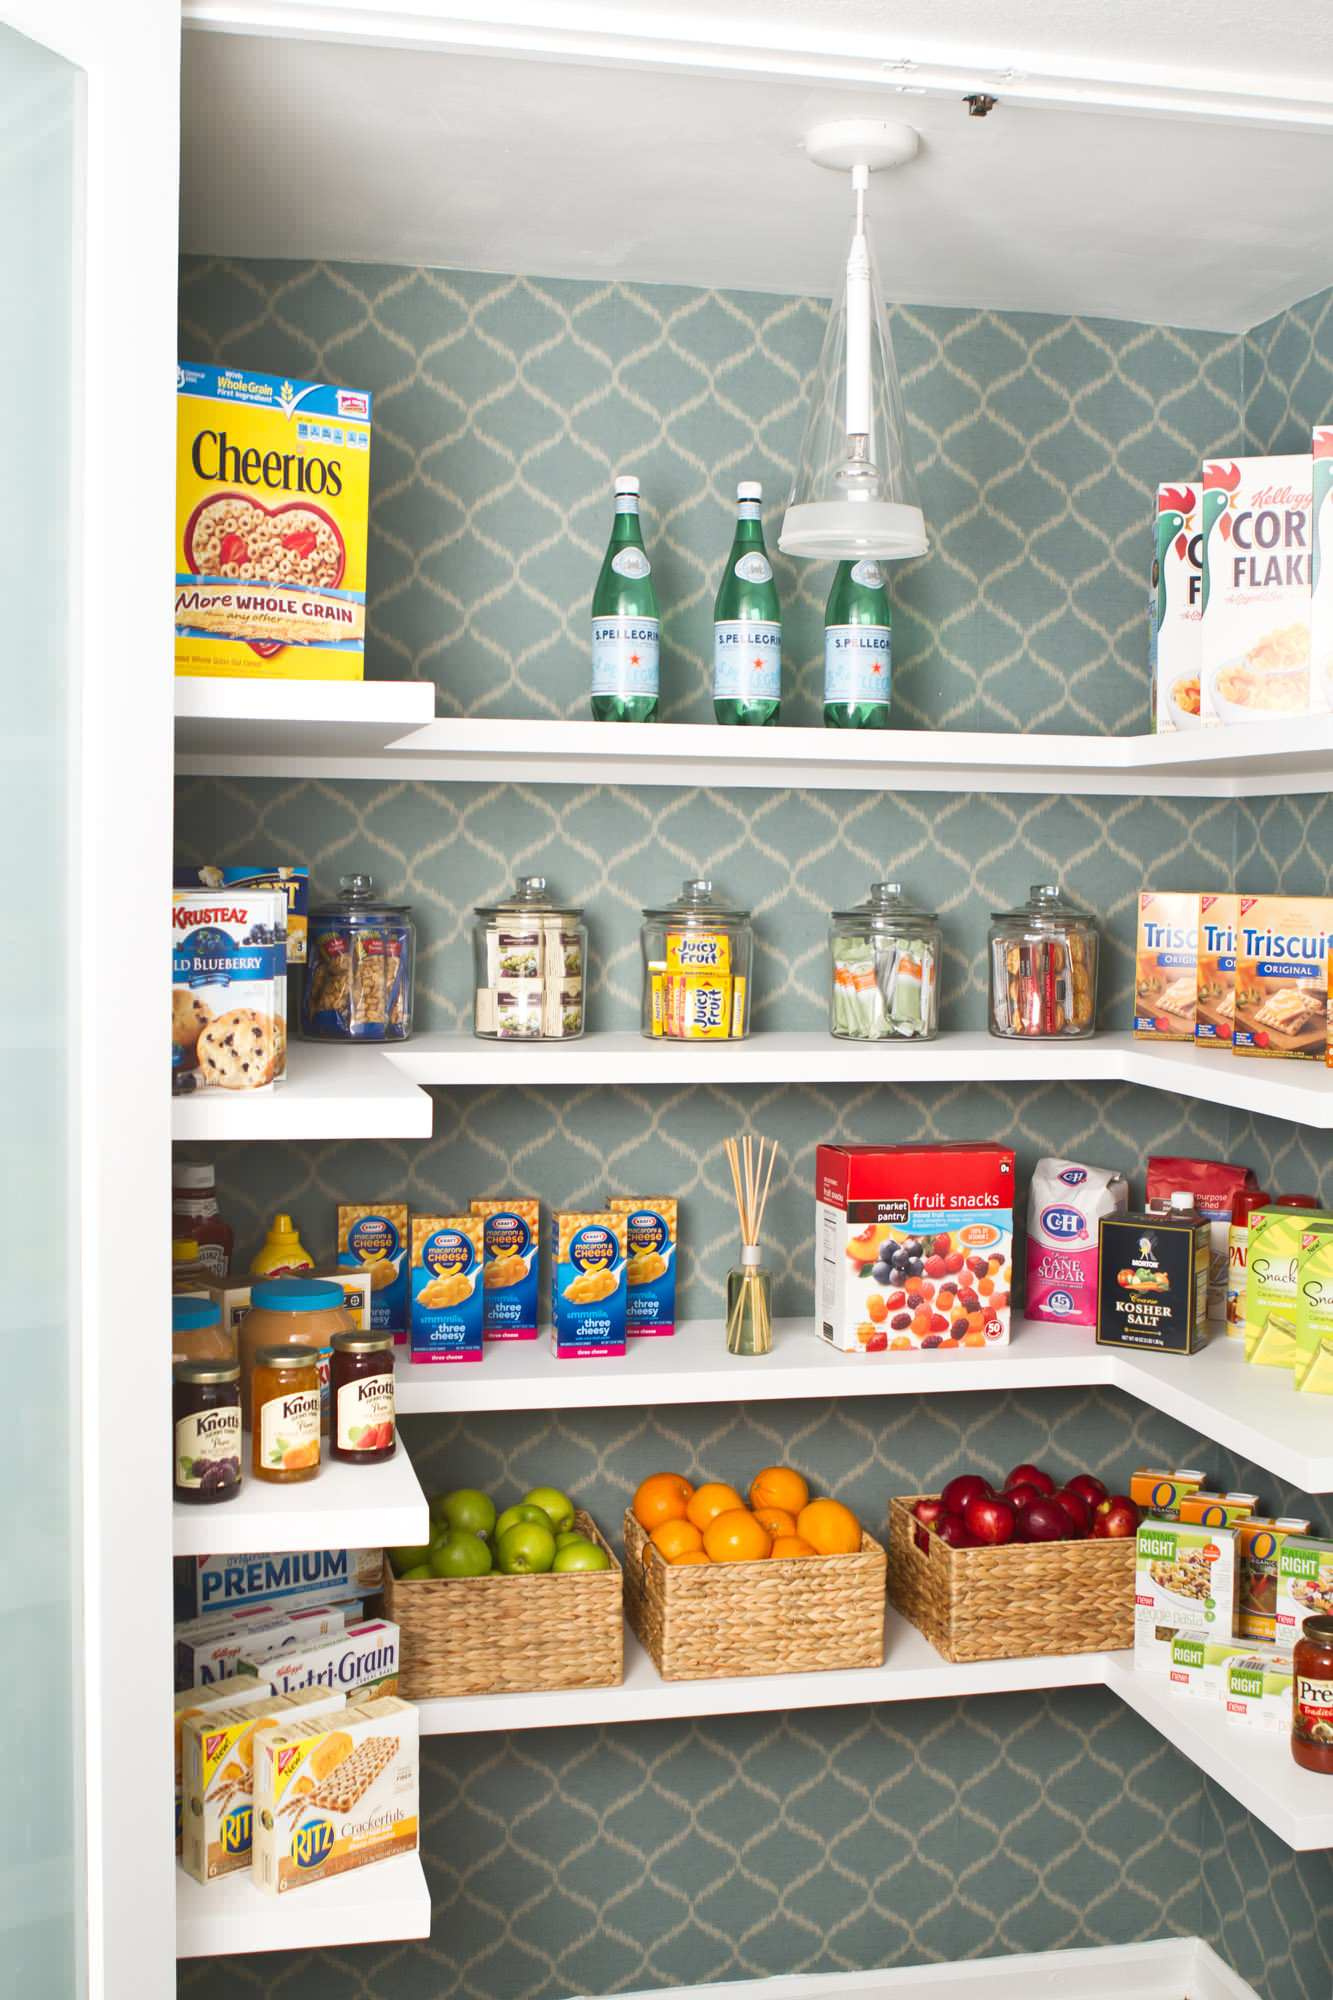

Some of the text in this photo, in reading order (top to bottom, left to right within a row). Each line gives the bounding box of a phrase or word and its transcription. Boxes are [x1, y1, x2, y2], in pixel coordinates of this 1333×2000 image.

[217, 375, 247, 392] Whole
[248, 380, 274, 396] Grain
[191, 430, 343, 497] Cheerios
[1231, 510, 1307, 549] COR
[175, 592, 353, 623] More WHOLE GRAIN
[173, 906, 249, 929] KRUSTEAZ
[677, 940, 717, 953] Juicy
[193, 956, 262, 972] BLUEBERRY
[680, 952, 717, 964] Fruit
[1263, 964, 1313, 976] ORIGINAL
[694, 988, 709, 1028] Juicy
[707, 988, 722, 1026] Fruit
[1061, 1171, 1083, 1183] C&H
[878, 1202, 907, 1211] market
[913, 1193, 999, 1208] fruit snacks
[877, 1212, 906, 1223] pantry
[1046, 1213, 1079, 1233] C&H
[575, 1242, 608, 1250] macaroni
[1042, 1256, 1081, 1271] CANE
[1131, 1259, 1160, 1269] MORTON
[1251, 1258, 1297, 1284] Snack
[1038, 1266, 1085, 1282] SUGAR
[1054, 1296, 1067, 1305] 15
[1303, 1281, 1333, 1307] Sna
[495, 1303, 522, 1312] three
[634, 1299, 660, 1308] three
[1115, 1301, 1173, 1318] KOSHER
[488, 1312, 521, 1321] cheesy
[627, 1308, 660, 1317] cheesy
[438, 1323, 467, 1332] three
[583, 1318, 612, 1328] three
[987, 1323, 1000, 1333] 50
[1127, 1314, 1160, 1327] SALT
[430, 1332, 466, 1342] cheesy
[576, 1327, 610, 1337] cheesy
[1138, 1538, 1175, 1557] RIGHT
[1280, 1557, 1318, 1576] RIGHT
[202, 1549, 348, 1602] PREMIUM
[1173, 1647, 1204, 1666] RIGHT
[1231, 1677, 1262, 1696] RIGHT
[212, 1738, 231, 1763] New!
[284, 1752, 302, 1777] New!
[223, 1809, 253, 1853] RIT
[291, 1822, 333, 1865] RITZ
[208, 1862, 217, 1877] 6
[279, 1877, 288, 1890] 6
